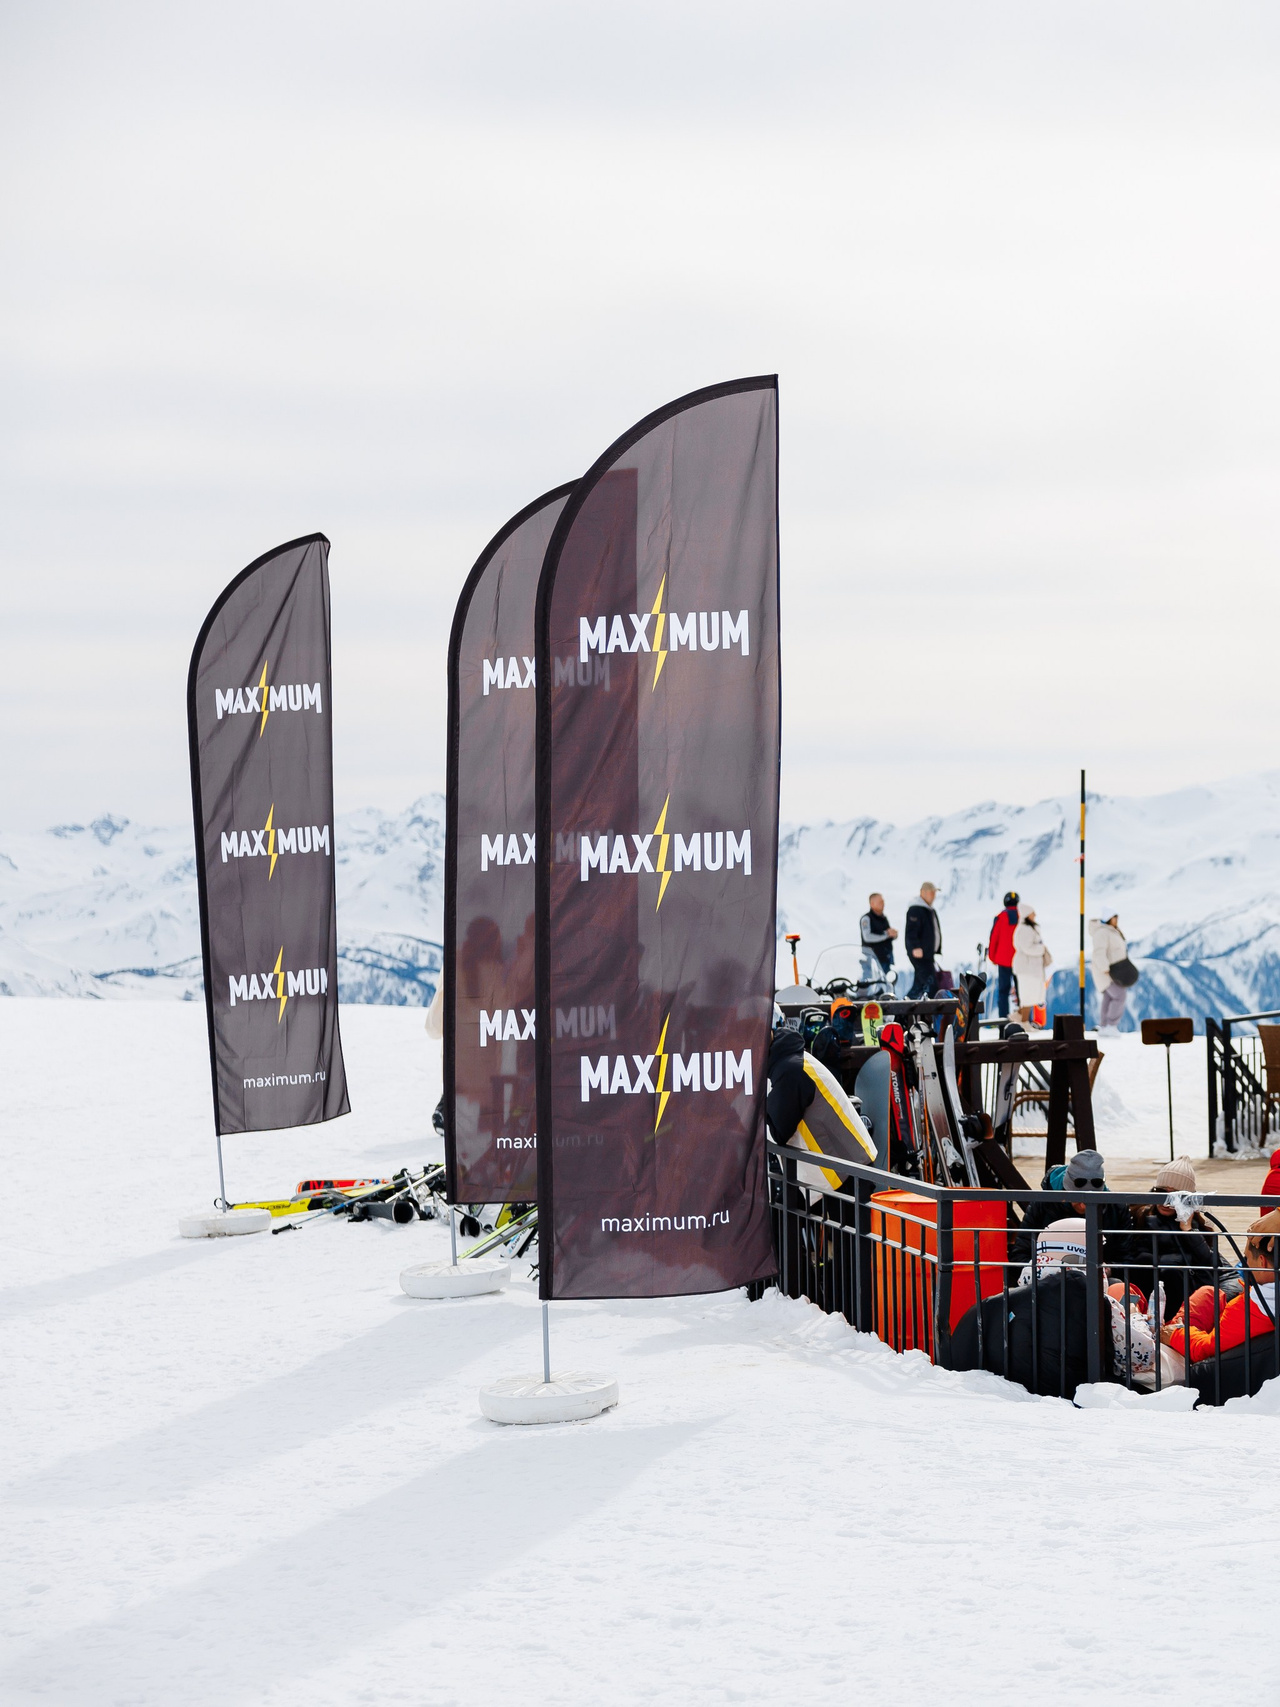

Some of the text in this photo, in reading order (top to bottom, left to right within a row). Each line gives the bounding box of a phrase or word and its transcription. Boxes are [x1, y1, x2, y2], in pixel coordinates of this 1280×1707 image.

[243, 1070, 326, 1089] maximum.ru
[890, 1070, 901, 1103] ATOMIC
[601, 1209, 730, 1232] maximum.ru
